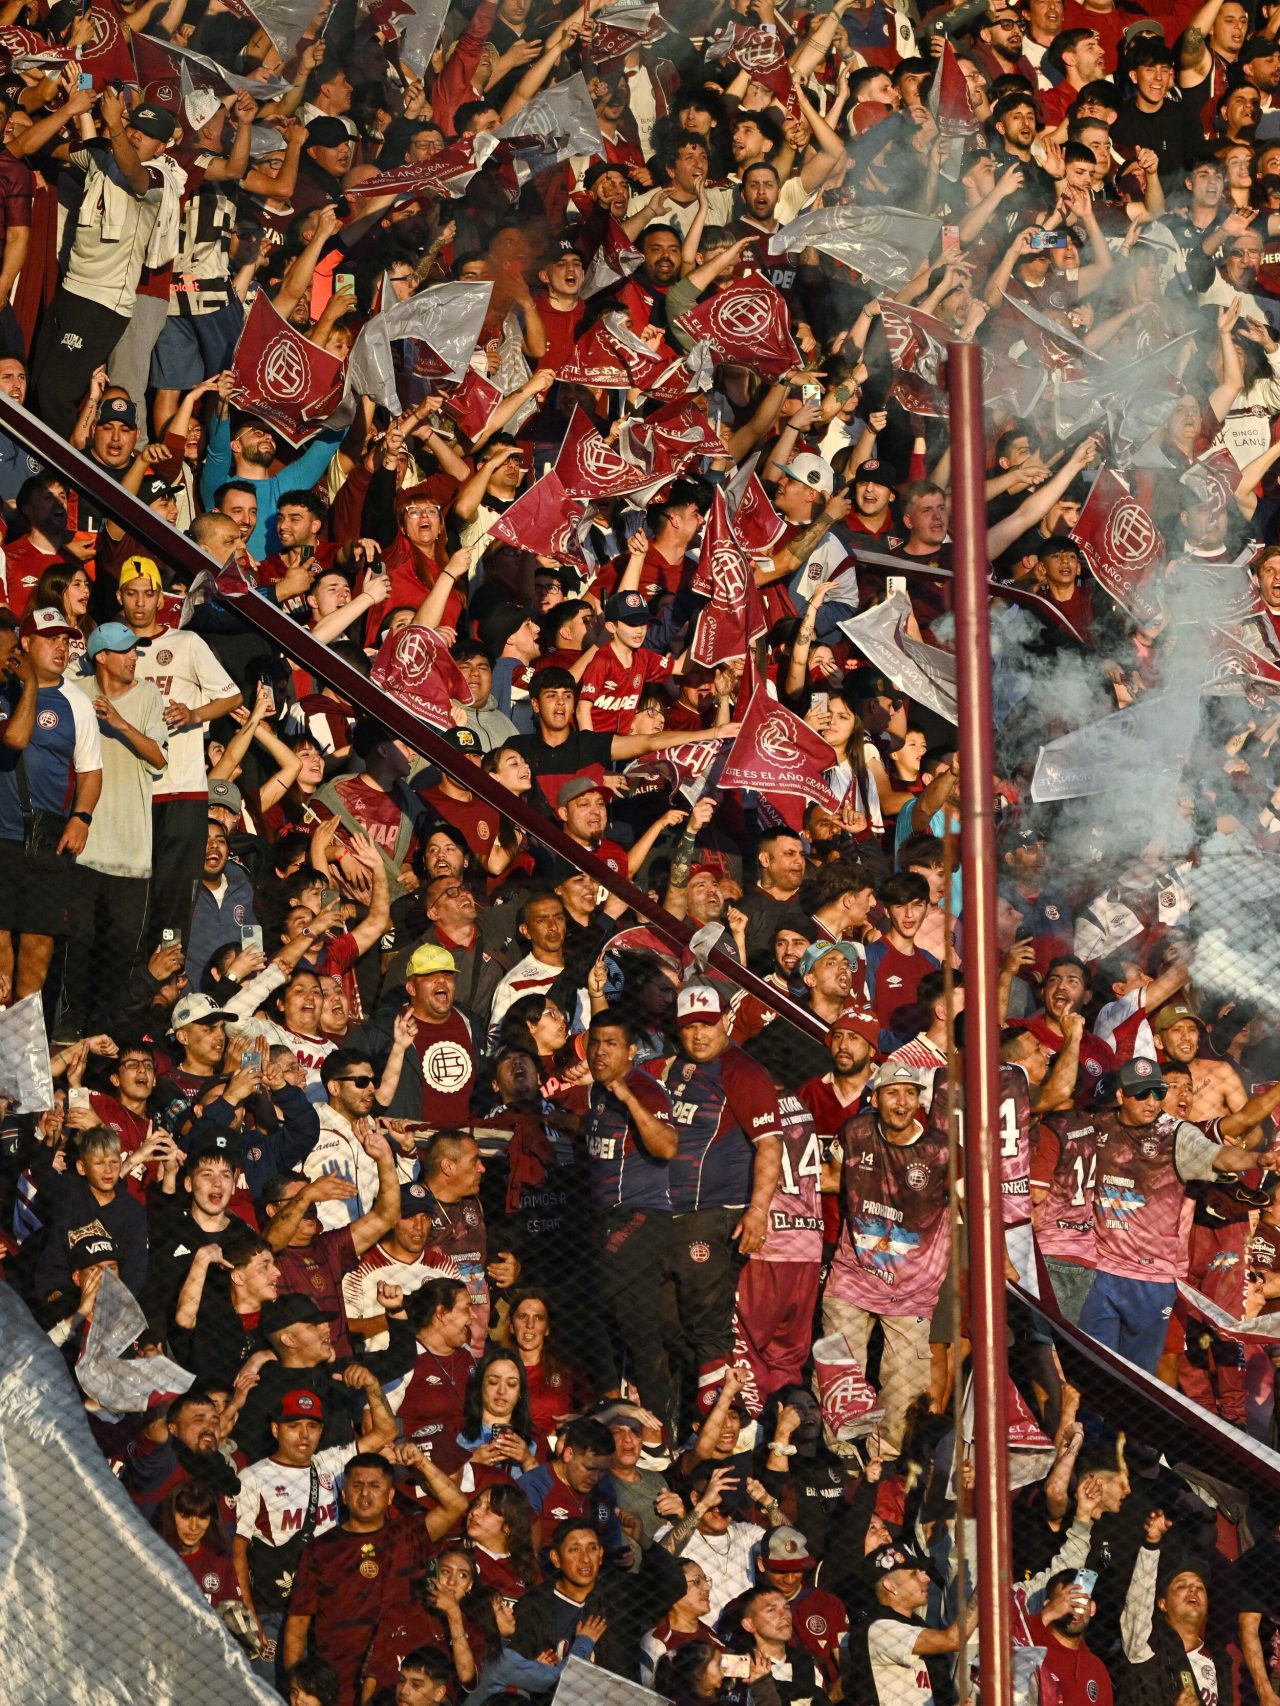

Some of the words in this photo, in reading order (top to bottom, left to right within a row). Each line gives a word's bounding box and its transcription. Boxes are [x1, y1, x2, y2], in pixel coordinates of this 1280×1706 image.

[60, 333, 83, 349] PUMA
[1232, 429, 1259, 437] BINGO
[594, 693, 640, 712] MAPEI
[725, 767, 742, 777] ESTE
[743, 769, 757, 779] ES
[762, 771, 776, 780] EL
[778, 771, 804, 783] AÑO
[689, 991, 709, 1008] 14
[860, 1151, 874, 1166] 14
[774, 1211, 791, 1230] EL
[85, 1241, 113, 1255] VANS
